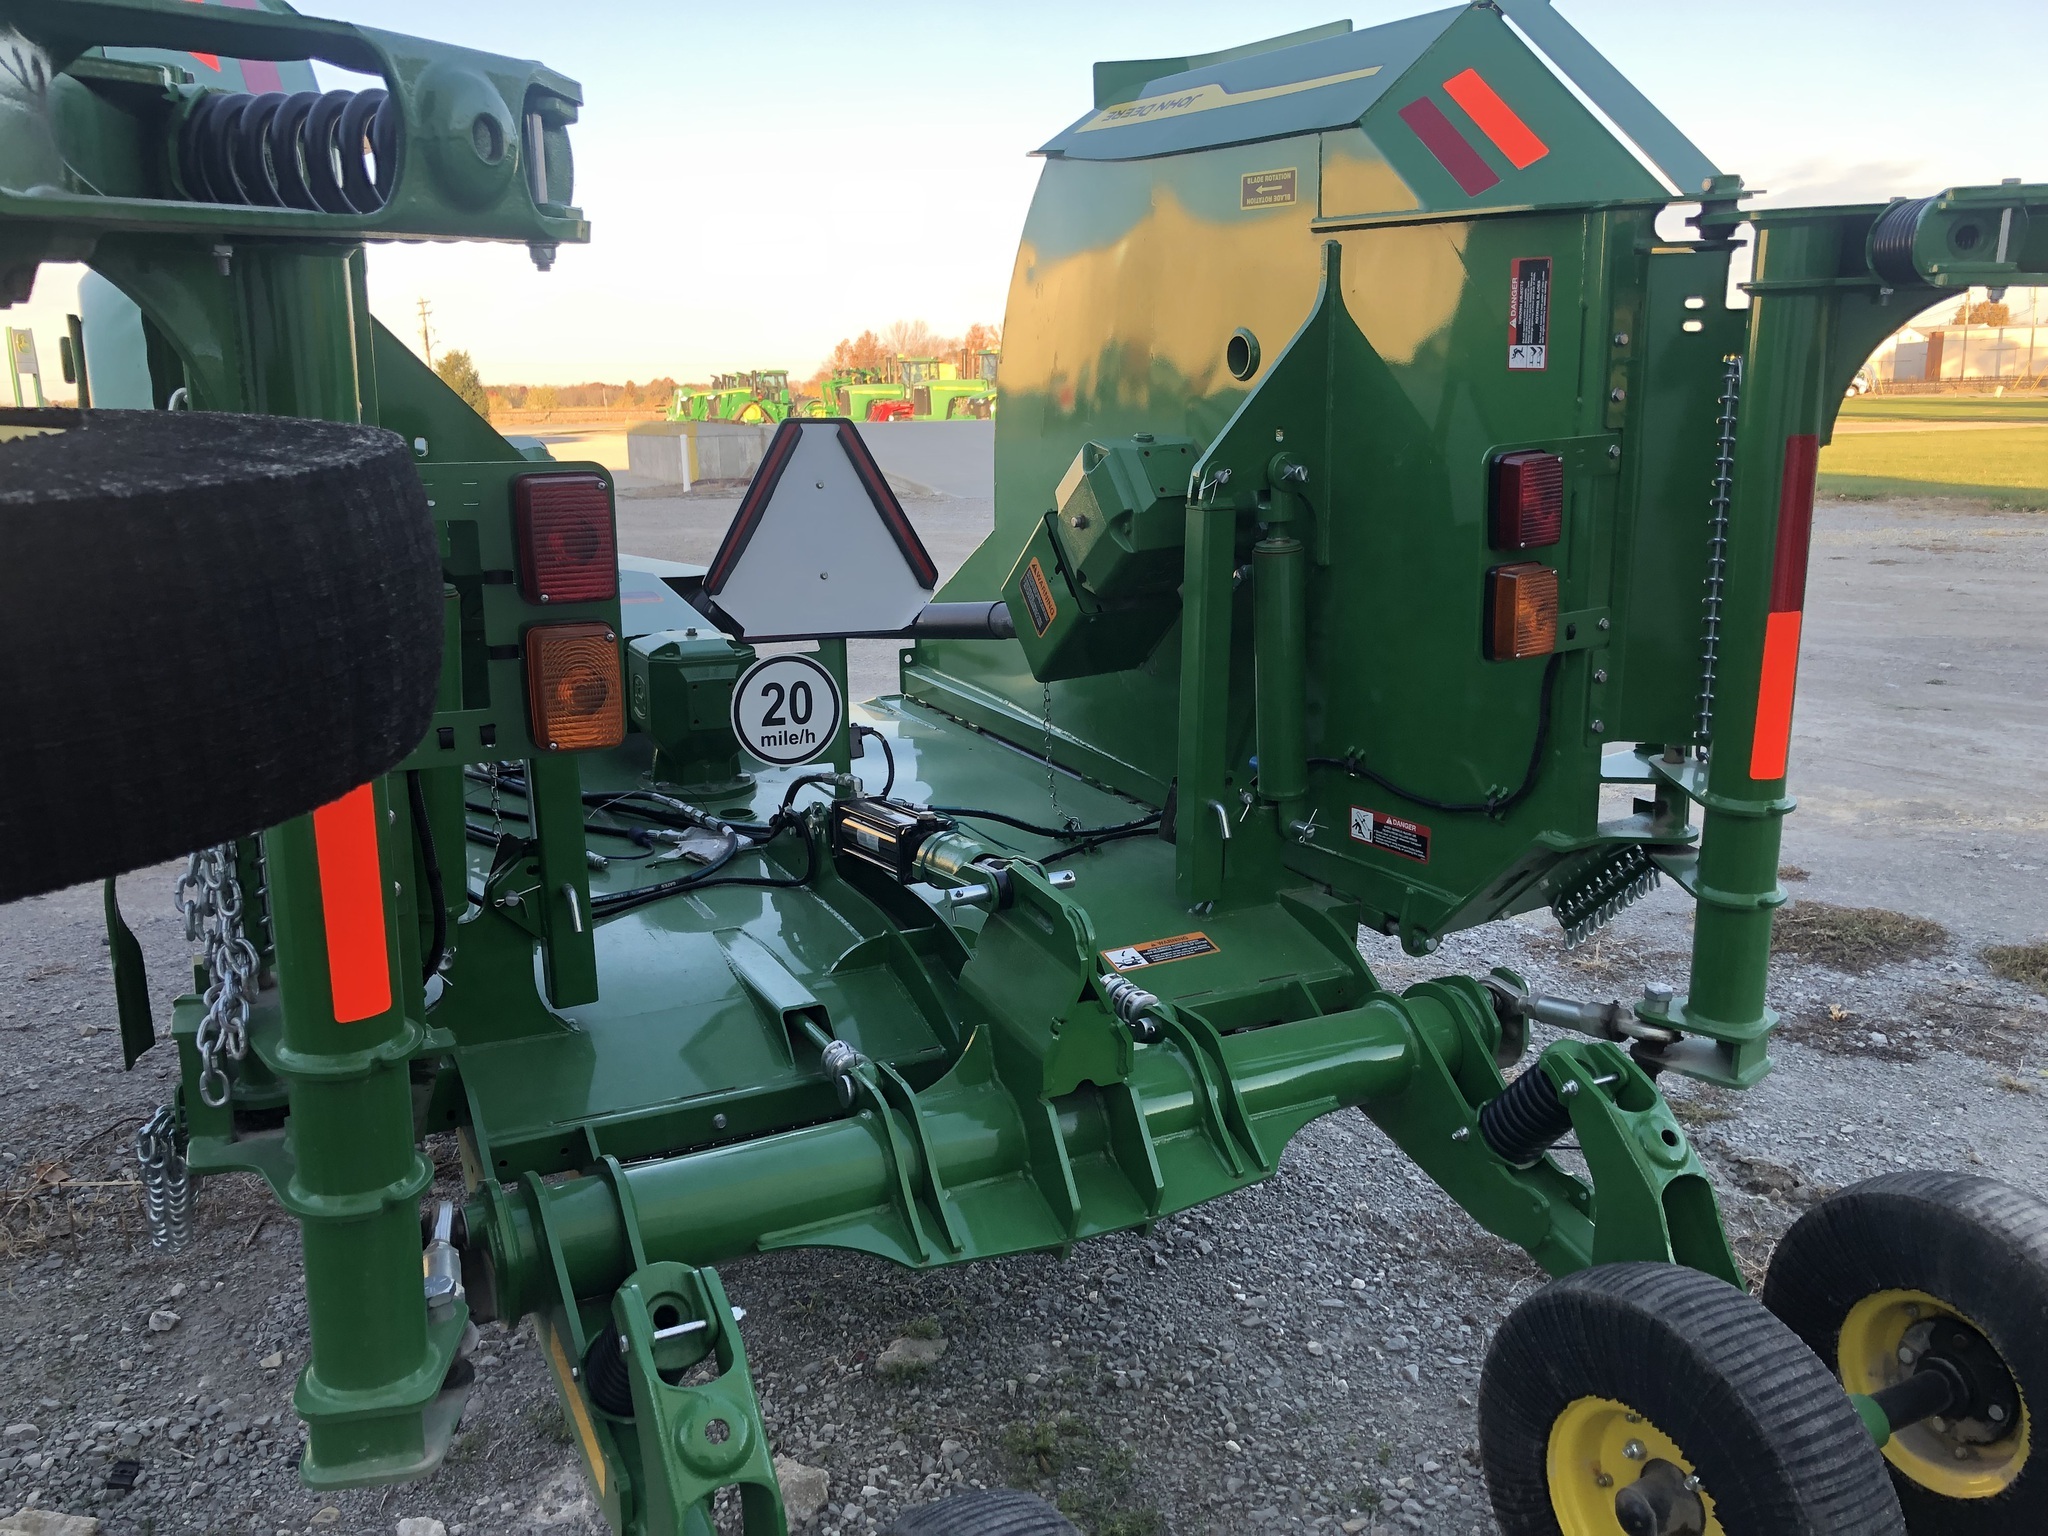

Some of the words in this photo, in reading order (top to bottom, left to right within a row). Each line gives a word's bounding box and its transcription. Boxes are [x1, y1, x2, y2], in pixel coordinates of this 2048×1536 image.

[1155, 93, 1204, 112] JOHN
[1102, 104, 1156, 122] DEERE
[1247, 175, 1263, 184] BLADE
[1264, 172, 1292, 182] ROTATION
[1036, 572, 1055, 616] WARNING
[761, 681, 813, 727] 20
[761, 728, 816, 748] mile/h
[1392, 818, 1417, 832] DANGER
[1157, 936, 1189, 946] WARNING
